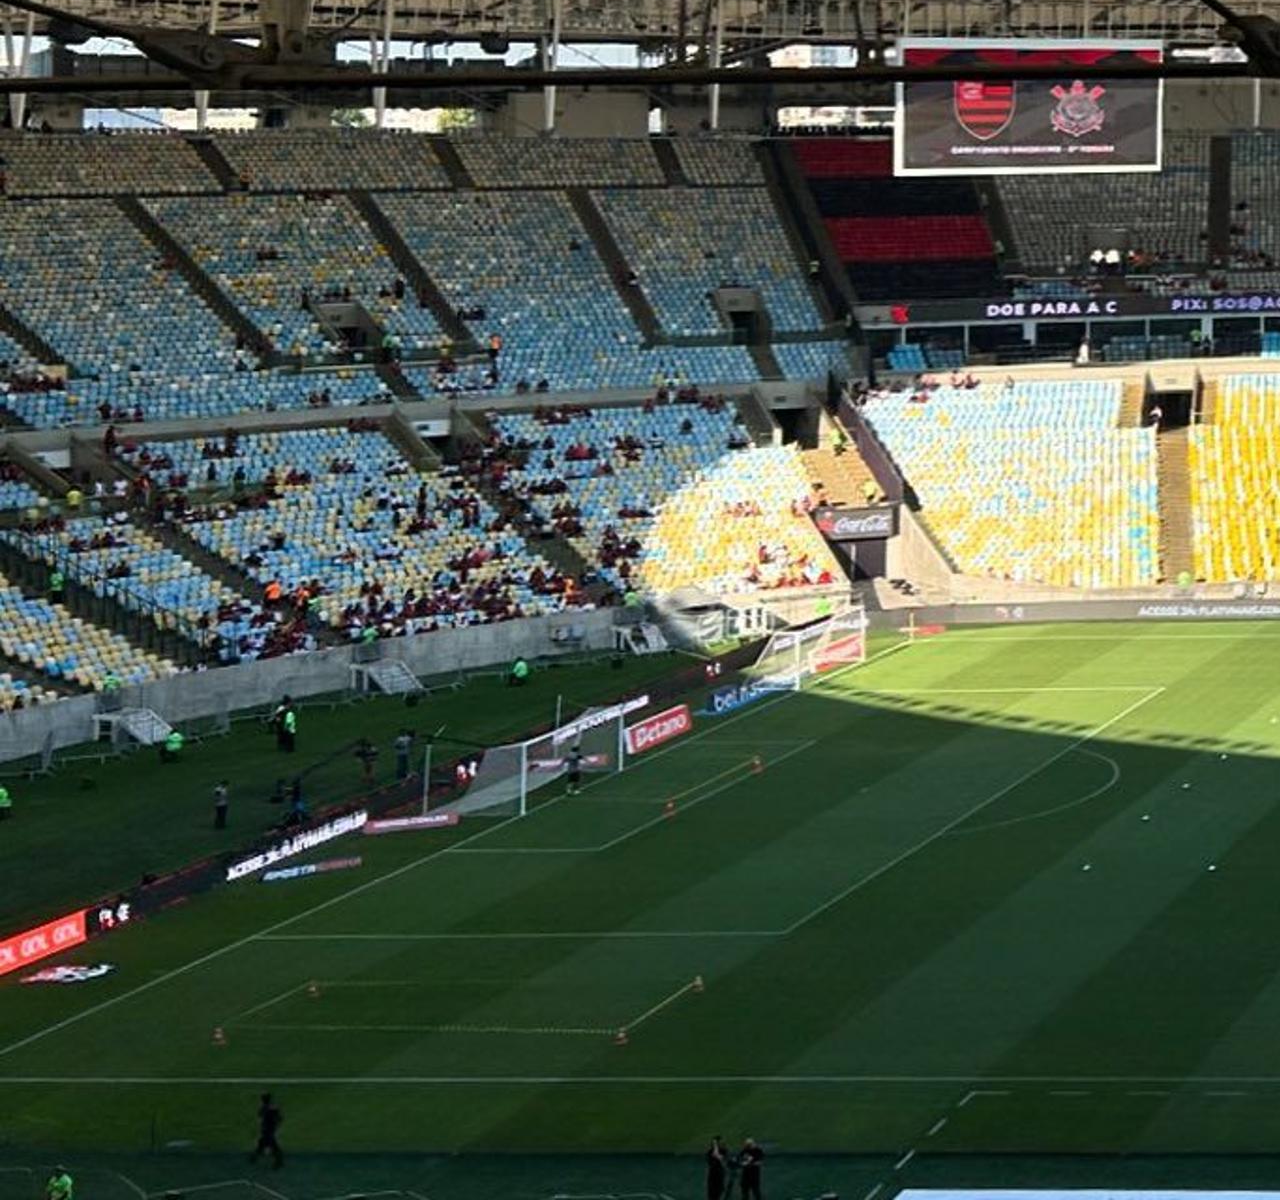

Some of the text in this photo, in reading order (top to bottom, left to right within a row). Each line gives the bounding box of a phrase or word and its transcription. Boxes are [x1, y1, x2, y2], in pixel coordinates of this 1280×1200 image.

[986, 301, 1118, 317] DOE PARA A C
[833, 514, 891, 534] Coca-Cola
[635, 712, 688, 750] Betano
